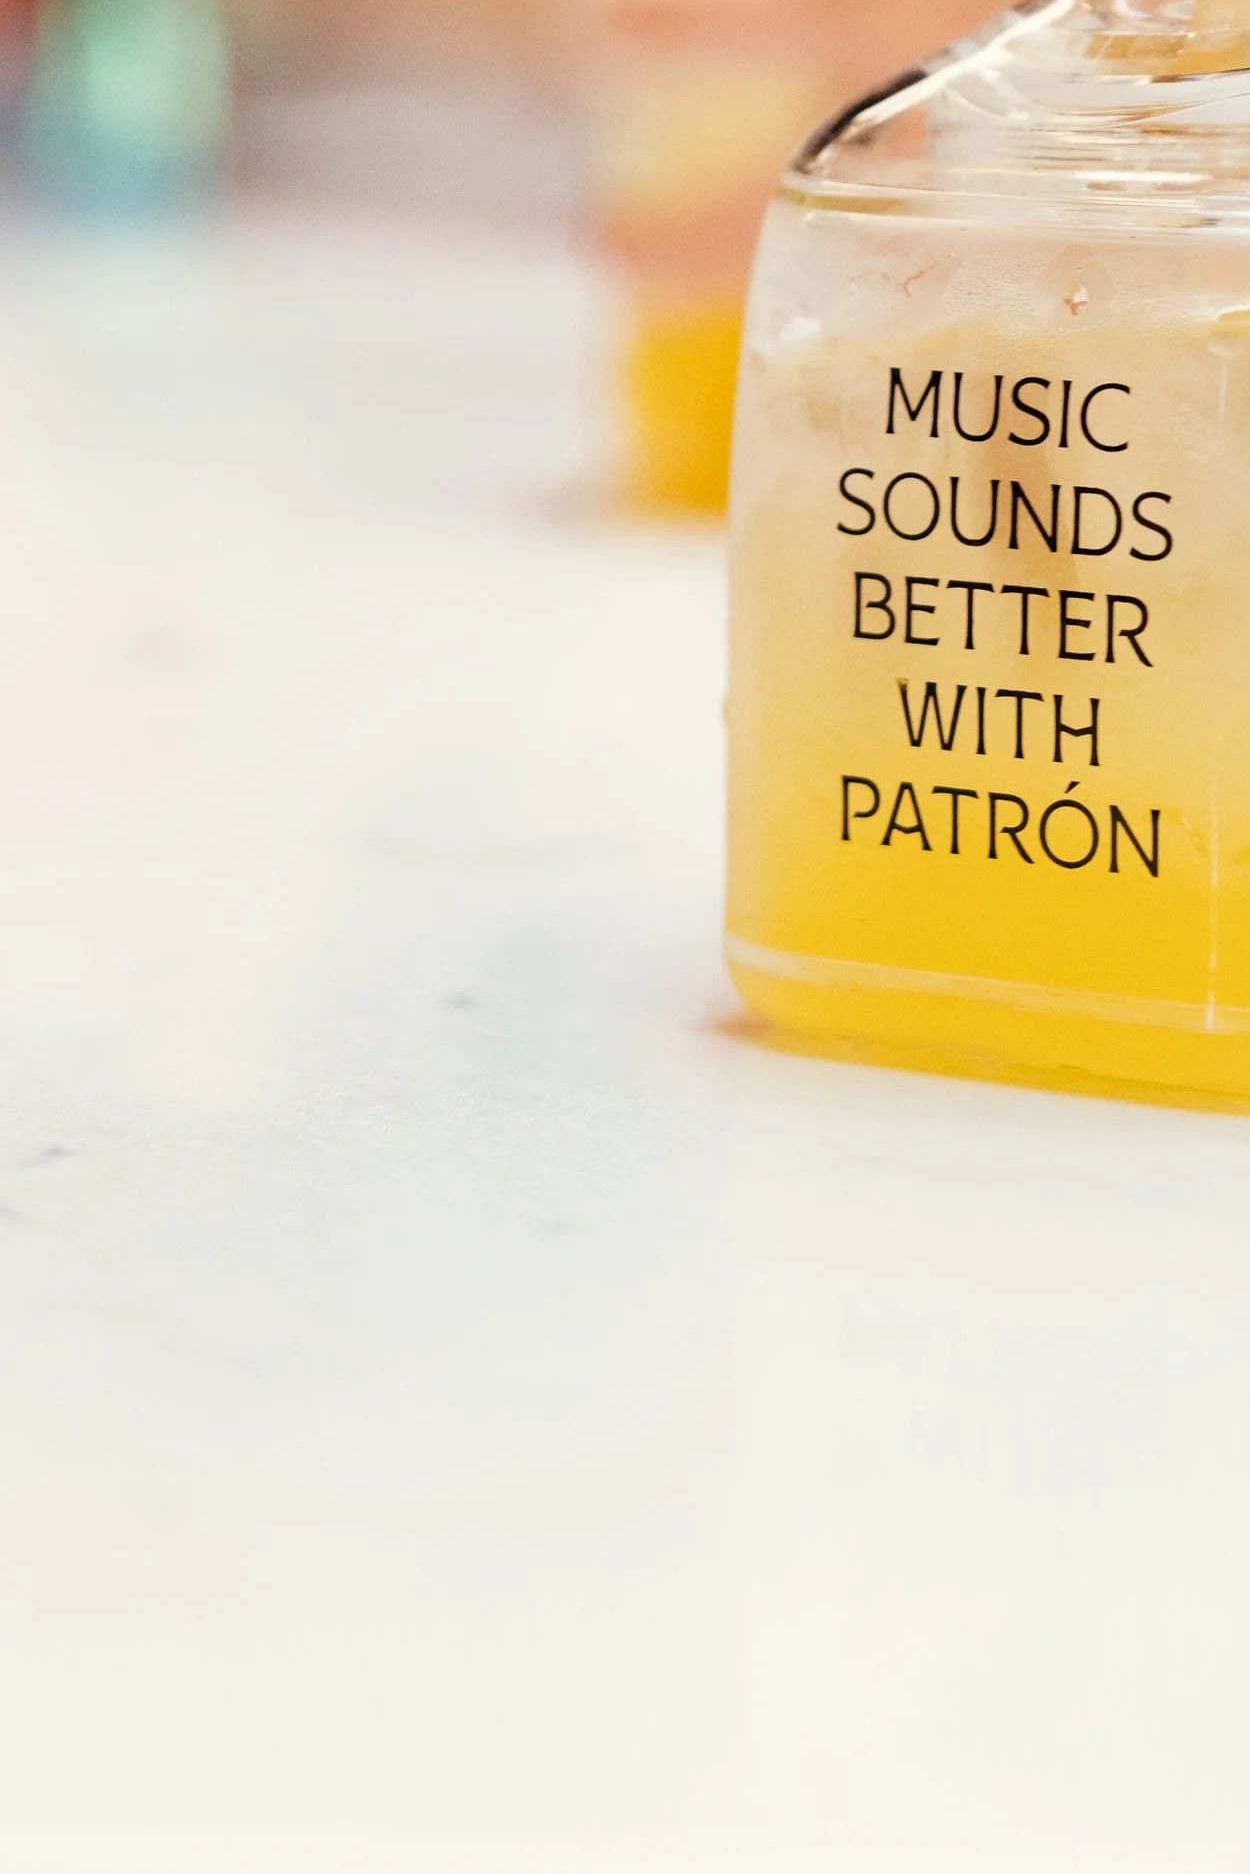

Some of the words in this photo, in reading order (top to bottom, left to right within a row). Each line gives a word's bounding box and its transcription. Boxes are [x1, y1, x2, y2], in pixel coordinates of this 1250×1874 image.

[885, 367, 1131, 453] MUSIC
[836, 467, 1173, 562] SOUNDS
[853, 571, 1154, 668] BETTER
[897, 679, 1101, 767] WITH
[841, 775, 1161, 878] PATRÓN
